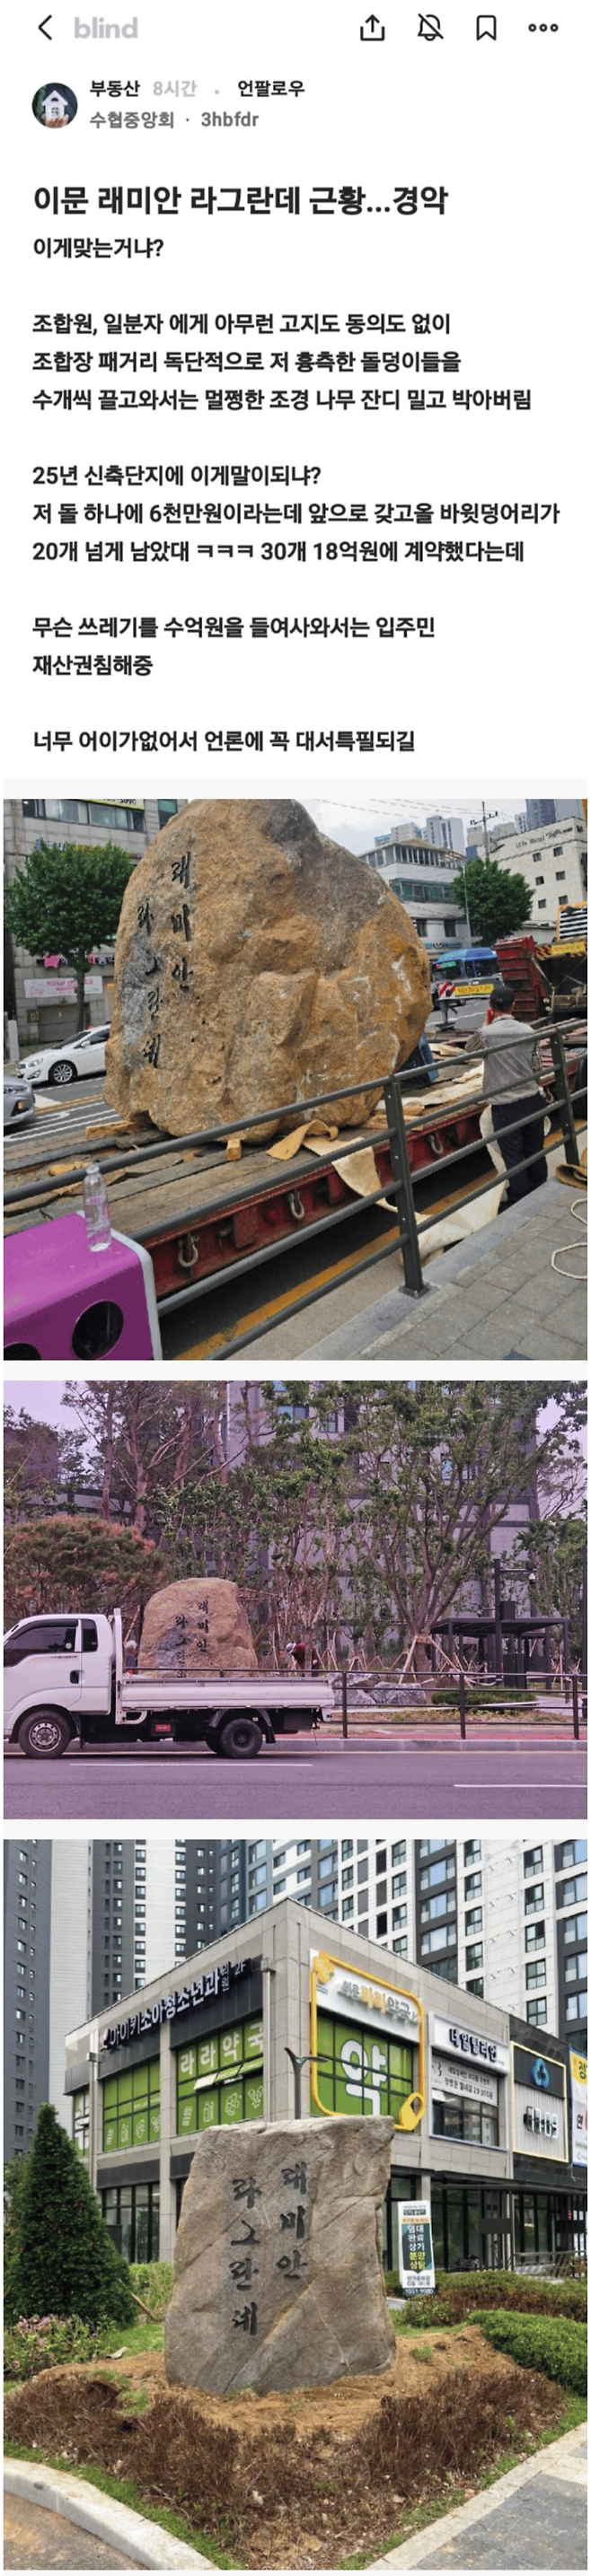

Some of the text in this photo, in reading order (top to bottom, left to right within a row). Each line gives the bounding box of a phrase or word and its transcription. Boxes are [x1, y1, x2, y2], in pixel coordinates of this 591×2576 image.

[75, 17, 137, 39] blind
[90, 80, 305, 98] 부동산 8시간 언팔로우
[90, 111, 259, 129] 수협중앙회 3hbfdr
[34, 186, 449, 215] 이문 래미안 라그란데 근황...경악
[33, 237, 163, 258] 이게맞는거냐?
[32, 313, 450, 336] 조합원, 일분자 에게 아무런 고지도 동의도 없이
[32, 351, 462, 372] 조합장 패거리 독단적으로 저 흉측한 돌덩이들을
[32, 390, 531, 411] 수개씩 끌고와서는 멀쩡한 조경 나무 잔디 밀고 박아버림
[32, 465, 322, 486] 25년 신축단지에 이게말이되냐?
[32, 503, 560, 524] 저 돌 하나에 6천만원이라는데 앞으로 갖고올 바윗덩어리가
[32, 541, 524, 562] 20개 넘게 남았대 ㅋㅋㅋ 30개 18억원에 계약했다는데
[32, 617, 435, 638] 무슨 쓰레기를 수억원을 들여사와서는 입주민
[32, 654, 154, 677] 재산권침해중
[34, 731, 415, 752] 너무 어이가없어서 언론에 꼭 대서특필되길
[172, 851, 193, 994] 래미안
[197, 1600, 210, 1652] 래미안
[340, 2038, 387, 2116] 약
[276, 2161, 309, 2281] 래미안
